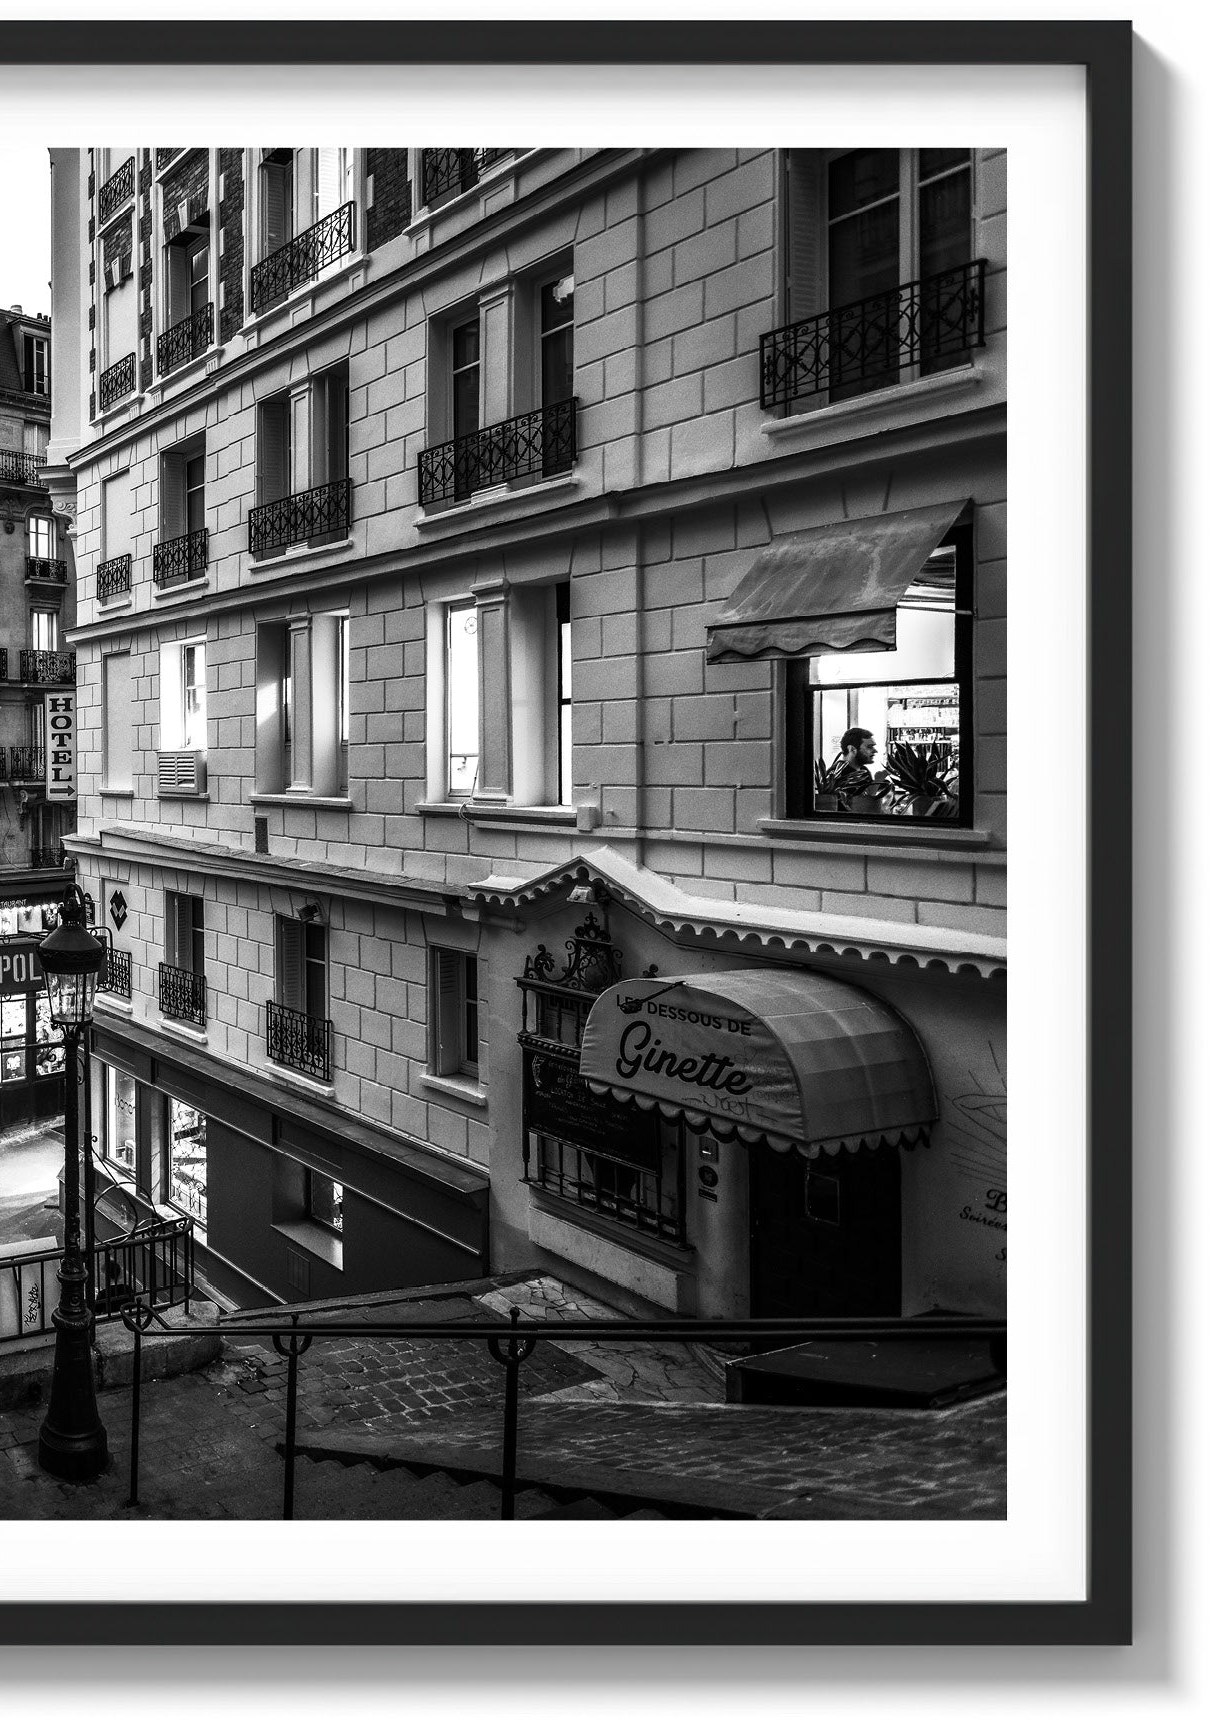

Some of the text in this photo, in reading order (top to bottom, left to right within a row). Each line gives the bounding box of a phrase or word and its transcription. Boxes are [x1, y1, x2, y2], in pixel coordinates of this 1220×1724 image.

[49, 697, 73, 782] HOTEL
[647, 1002, 722, 1030] DESSOUS
[727, 1018, 752, 1037] DE
[616, 1020, 754, 1096] Ginette
